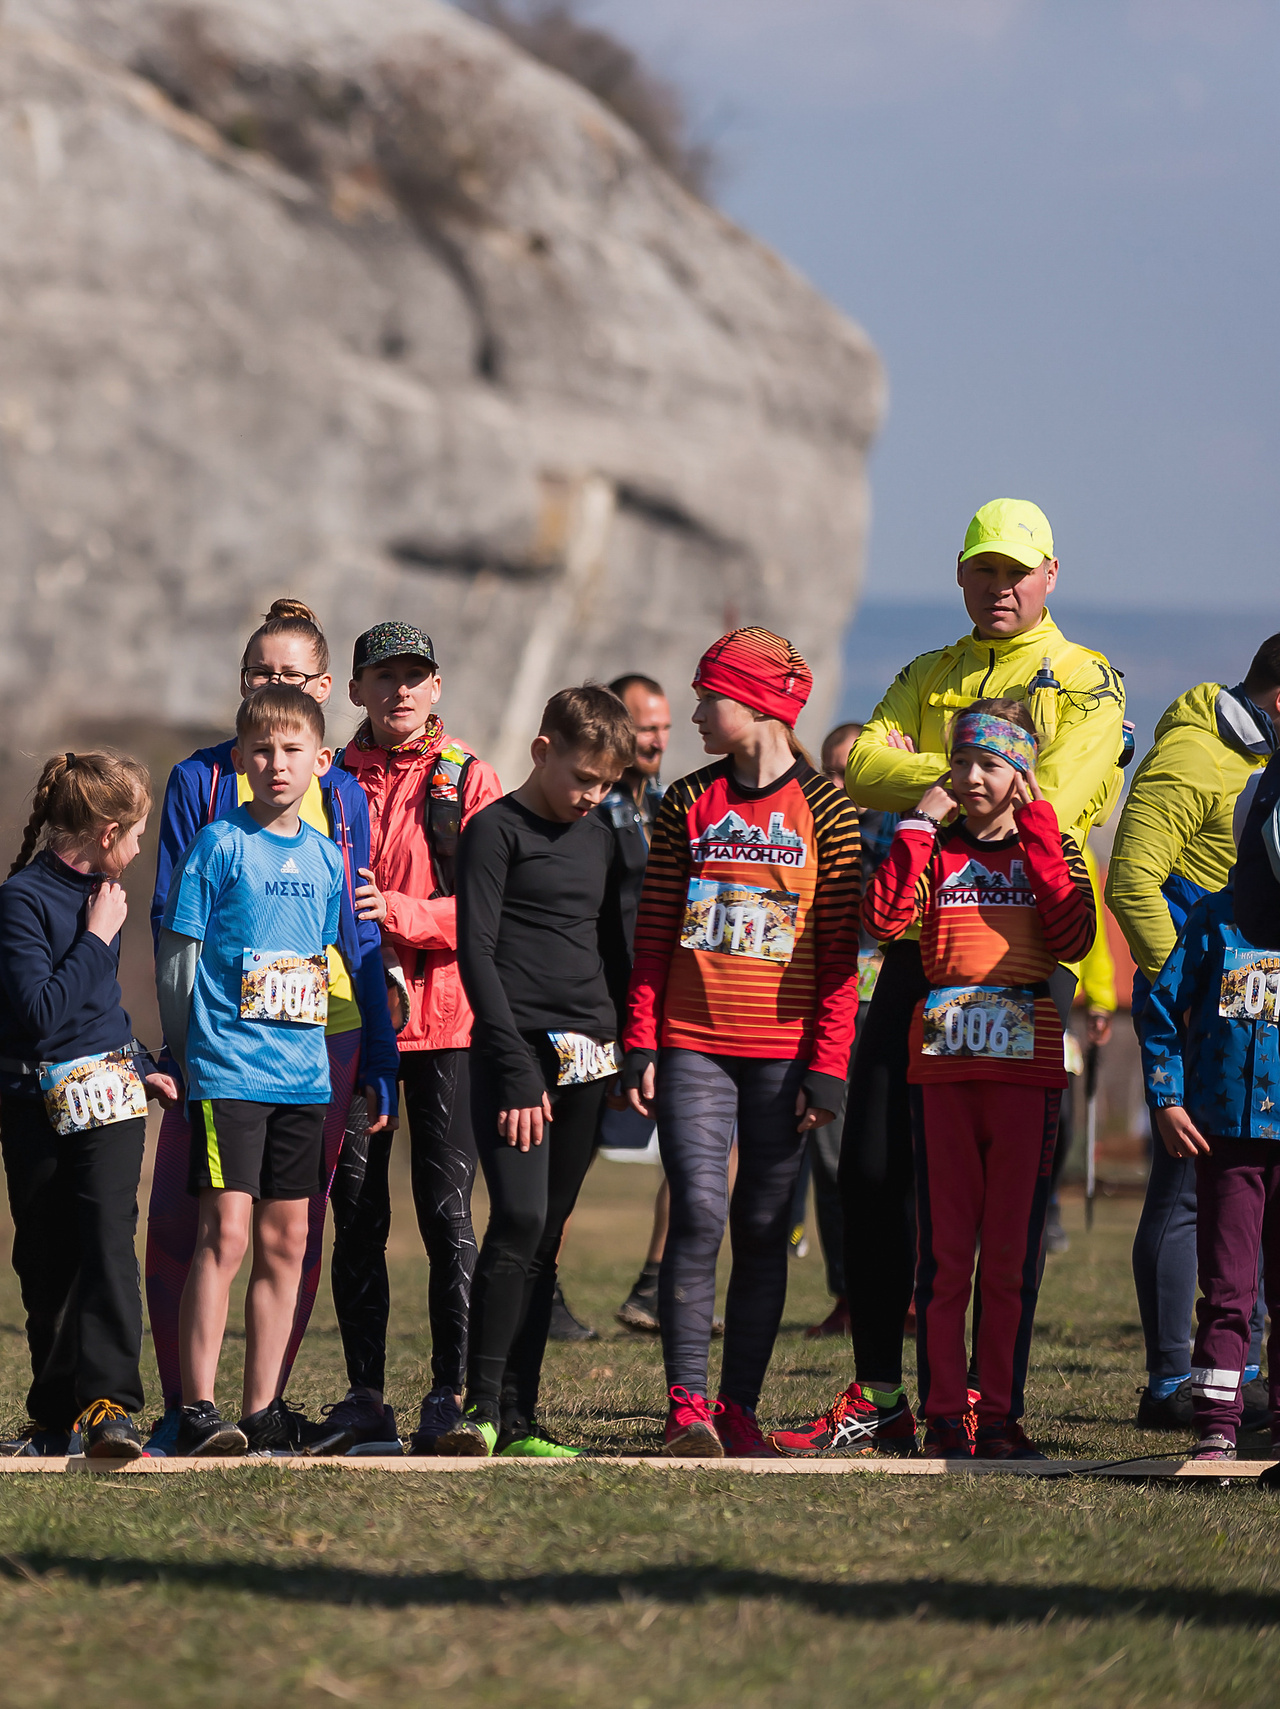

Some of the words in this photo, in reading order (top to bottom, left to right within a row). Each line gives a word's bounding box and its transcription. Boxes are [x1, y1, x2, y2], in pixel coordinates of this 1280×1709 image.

[265, 881, 314, 898] MESSI
[706, 903, 767, 953] 011
[265, 971, 316, 1018] 004
[945, 1006, 1009, 1052] 006
[65, 1073, 128, 1126] 002
